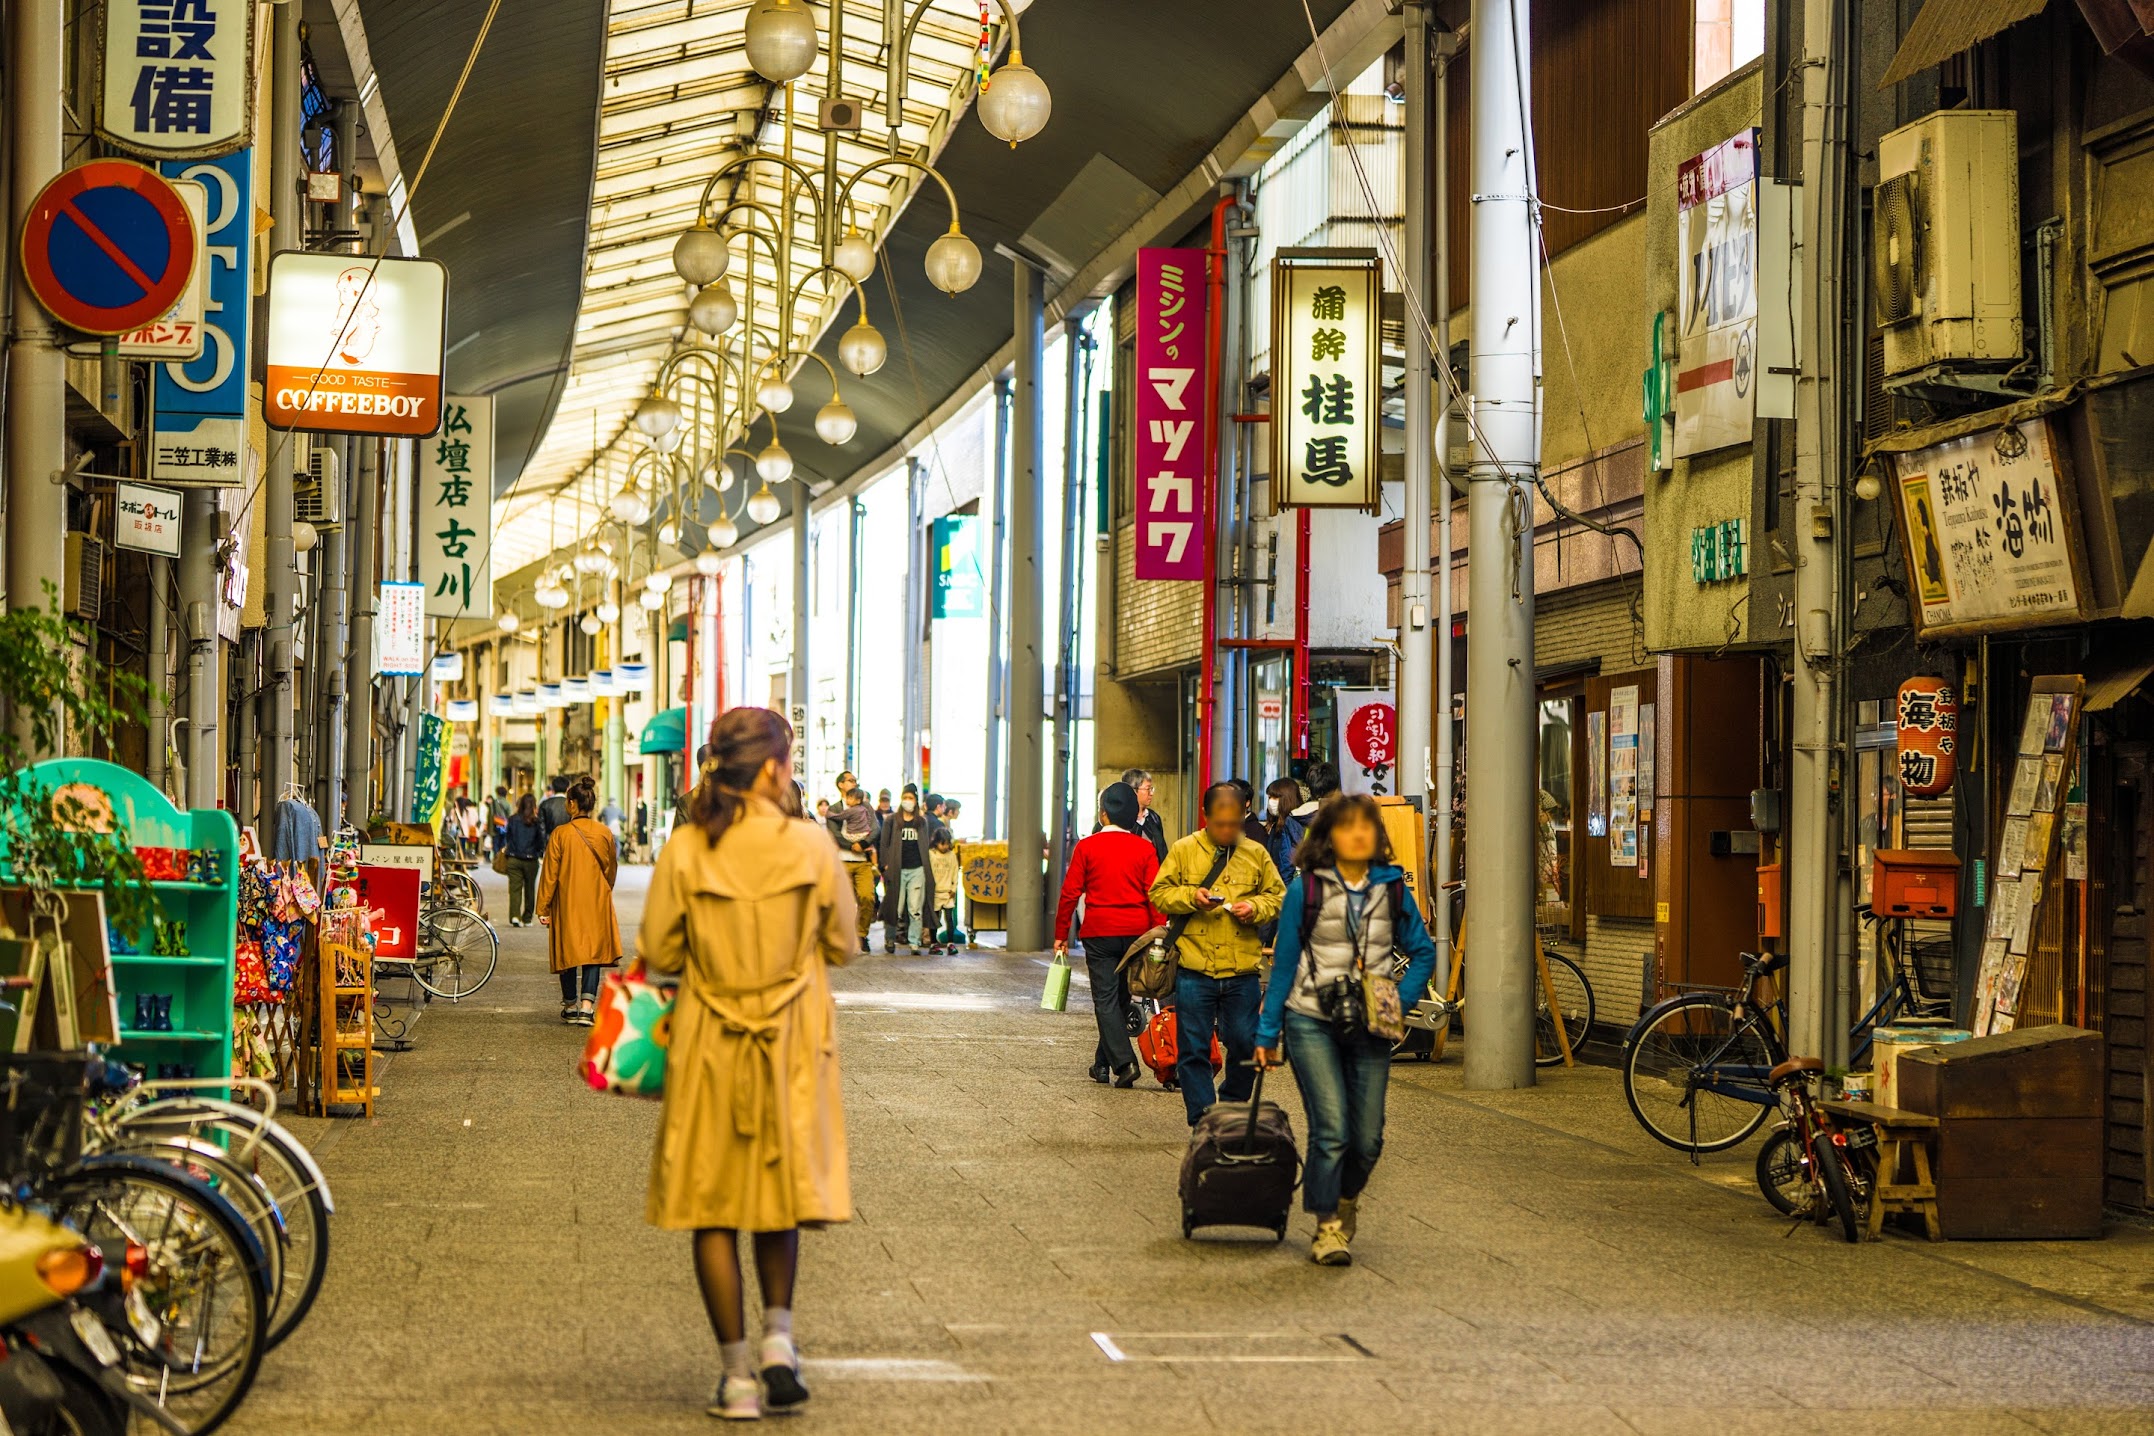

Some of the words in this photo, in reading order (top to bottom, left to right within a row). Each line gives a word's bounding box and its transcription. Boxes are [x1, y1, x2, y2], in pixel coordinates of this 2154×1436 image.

[310, 373, 346, 387] GOOD
[351, 375, 390, 388] TASTE
[276, 388, 426, 418] COFFEEBOY
[1147, 367, 1196, 564] マツカワ
